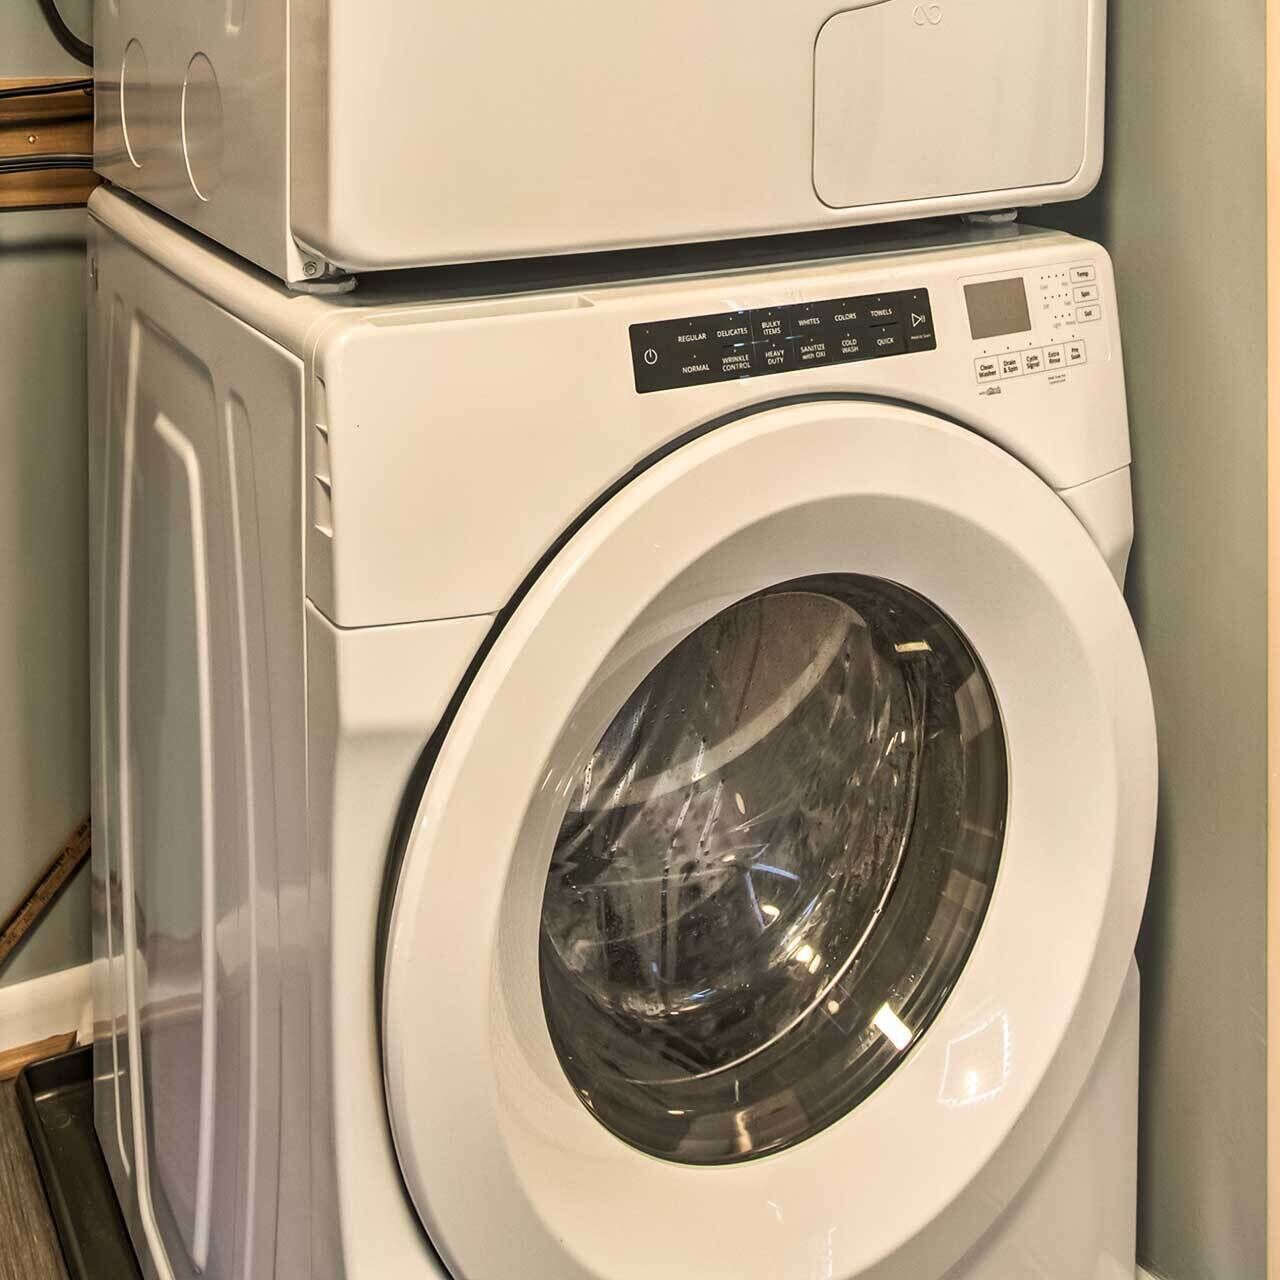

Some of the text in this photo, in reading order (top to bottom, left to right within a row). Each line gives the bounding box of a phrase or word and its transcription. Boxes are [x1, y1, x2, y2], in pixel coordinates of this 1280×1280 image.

[834, 312, 857, 322] COLORS
[870, 308, 893, 317] TOWELS
[761, 320, 781, 329] BULKY
[798, 317, 821, 327] WHITES
[717, 327, 748, 338] DELICATES
[763, 327, 782, 336] ITEMS
[677, 332, 707, 343] REGULAR
[841, 338, 858, 347] COLD
[876, 337, 894, 346] QUICK
[800, 343, 825, 354] SANITIZE
[841, 346, 859, 354] WASH
[722, 354, 749, 364] WRINKLE
[765, 349, 785, 359] HEAVY
[767, 357, 784, 366] DUTY
[682, 363, 710, 374] NORMAL
[722, 362, 752, 372] CONTROL
